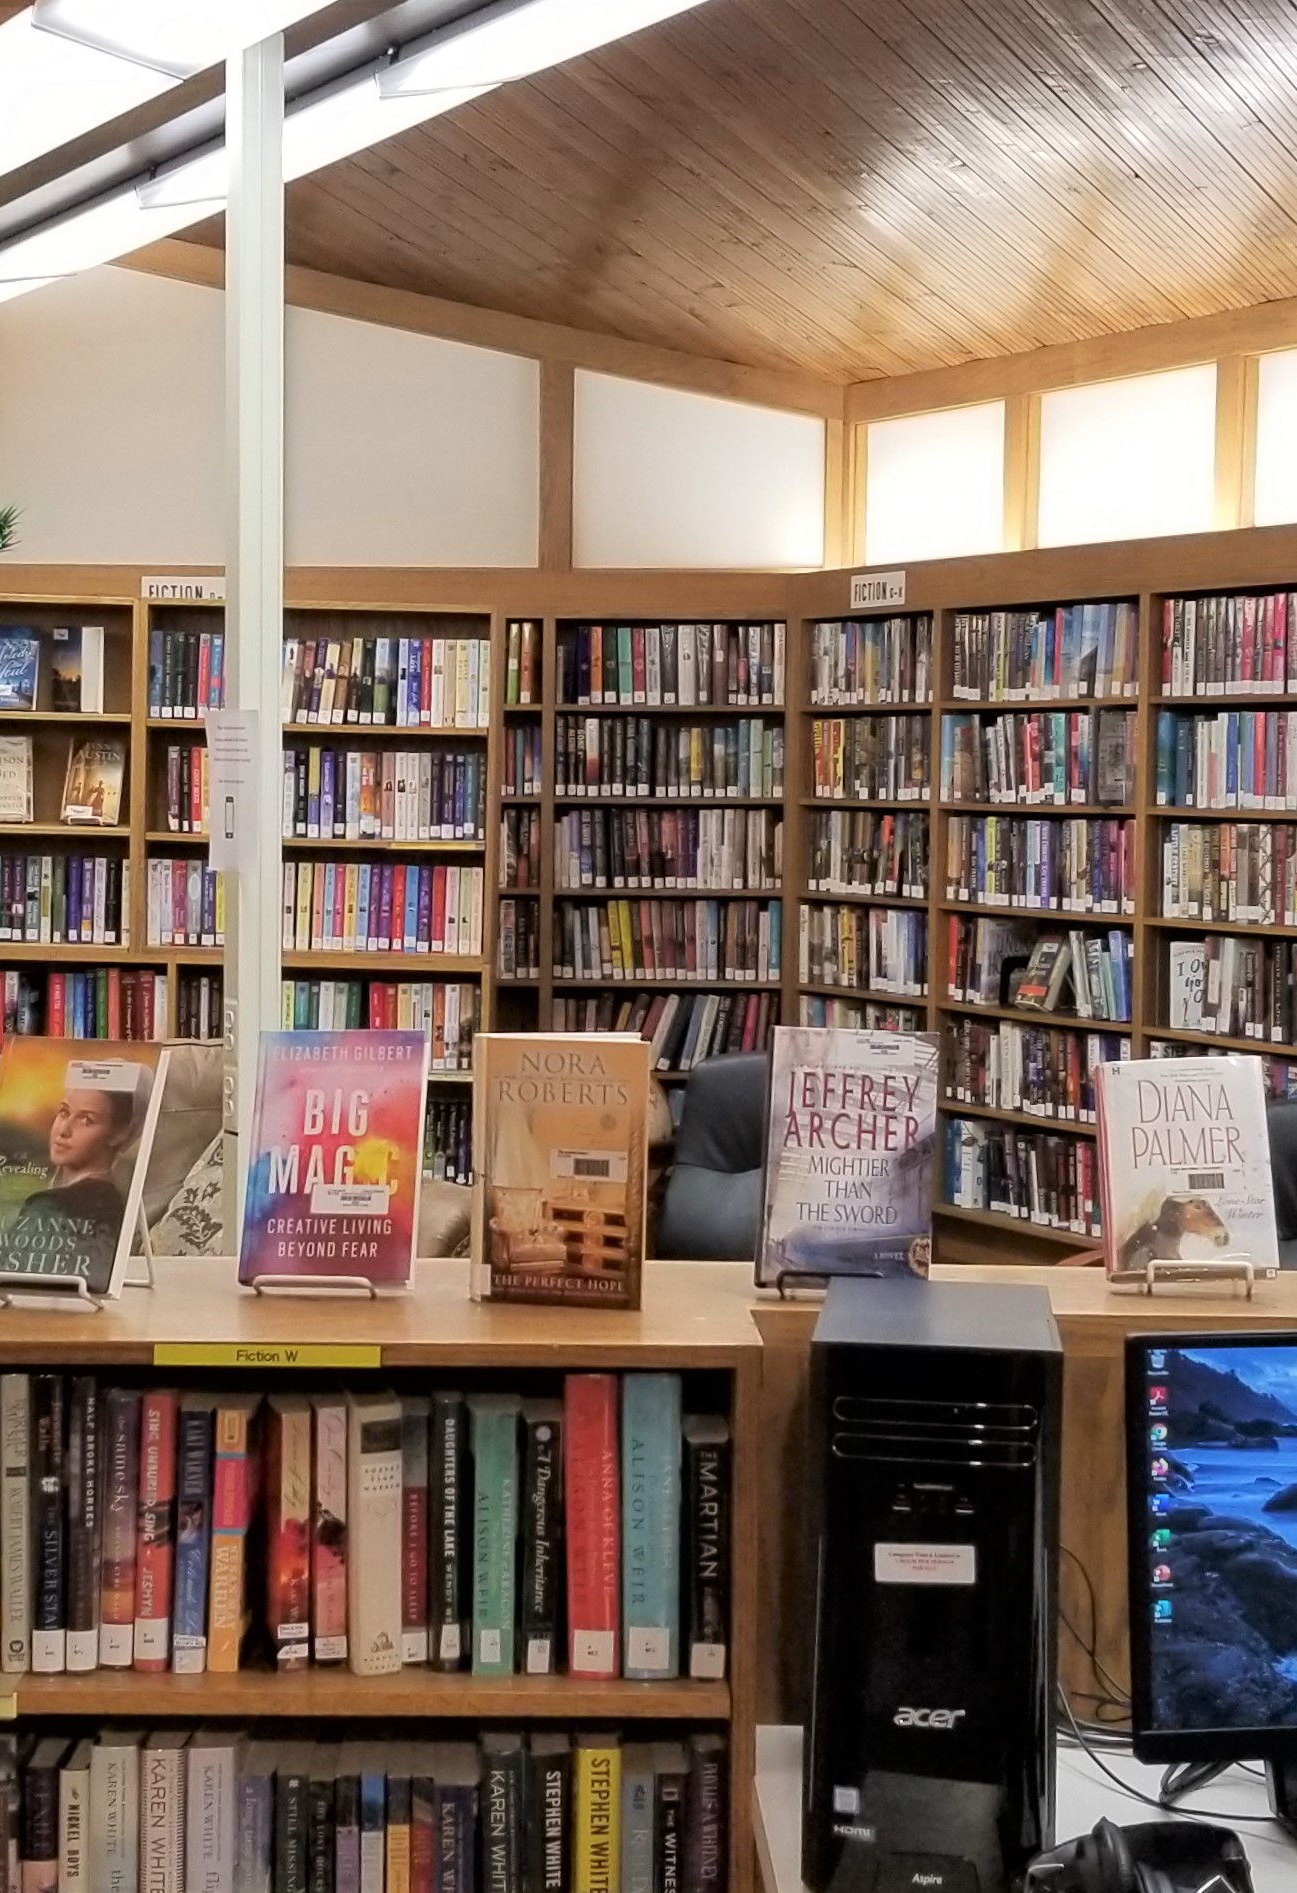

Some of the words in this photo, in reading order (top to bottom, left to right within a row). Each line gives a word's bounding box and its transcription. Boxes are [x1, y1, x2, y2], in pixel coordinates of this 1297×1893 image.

[854, 581, 887, 603] FICTION
[273, 1047, 348, 1061] ELIZABETH
[354, 1045, 413, 1061] GILBERT
[521, 1052, 606, 1075] NORA
[304, 1089, 370, 1137] BIG
[499, 1081, 628, 1106] ROBERTS
[786, 1071, 921, 1117] JEFFREY
[1137, 1080, 1234, 1124] DIANA
[783, 1111, 919, 1151] ARCHER
[1132, 1127, 1245, 1169] PALMER
[808, 1155, 890, 1177] MIGHTIER
[824, 1180, 873, 1199] THAN
[267, 1218, 337, 1234] CREATIVE
[342, 1218, 392, 1235] LIVING
[797, 1202, 829, 1222] THE
[833, 1204, 898, 1225] SWORD
[278, 1242, 336, 1257] BEYOND
[341, 1242, 378, 1258] FEAR
[236, 1349, 279, 1363] Fiction
[285, 1349, 299, 1362] W
[444, 1419, 455, 1483] DAUGHTERS
[444, 1487, 455, 1501] OF
[532, 1466, 550, 1536] Dangerous
[632, 1439, 644, 1529] ALISON
[143, 1512, 156, 1541] SING
[444, 1505, 455, 1525] THE
[477, 1490, 488, 1561] ALISON
[700, 1462, 718, 1577] MARTIAN
[44, 1530, 58, 1589] SILVER
[444, 1530, 455, 1557] LAKE
[631, 1548, 644, 1604] WEIR
[44, 1595, 57, 1630] STA
[893, 1707, 966, 1729] acer
[107, 1762, 117, 1810] KAREN
[151, 1759, 166, 1828] KAREN
[204, 1767, 214, 1810] KAREN
[491, 1771, 505, 1836] KAREN
[546, 1771, 561, 1838] STEPHEN
[591, 1758, 611, 1835] STEPHEN
[67, 1804, 79, 1842] NICKEL
[442, 1803, 454, 1860] KAREN
[67, 1849, 79, 1877] BOYS
[492, 1844, 506, 1893] WHIT
[546, 1842, 561, 1888] WHITE
[912, 1873, 942, 1886] Aspire
